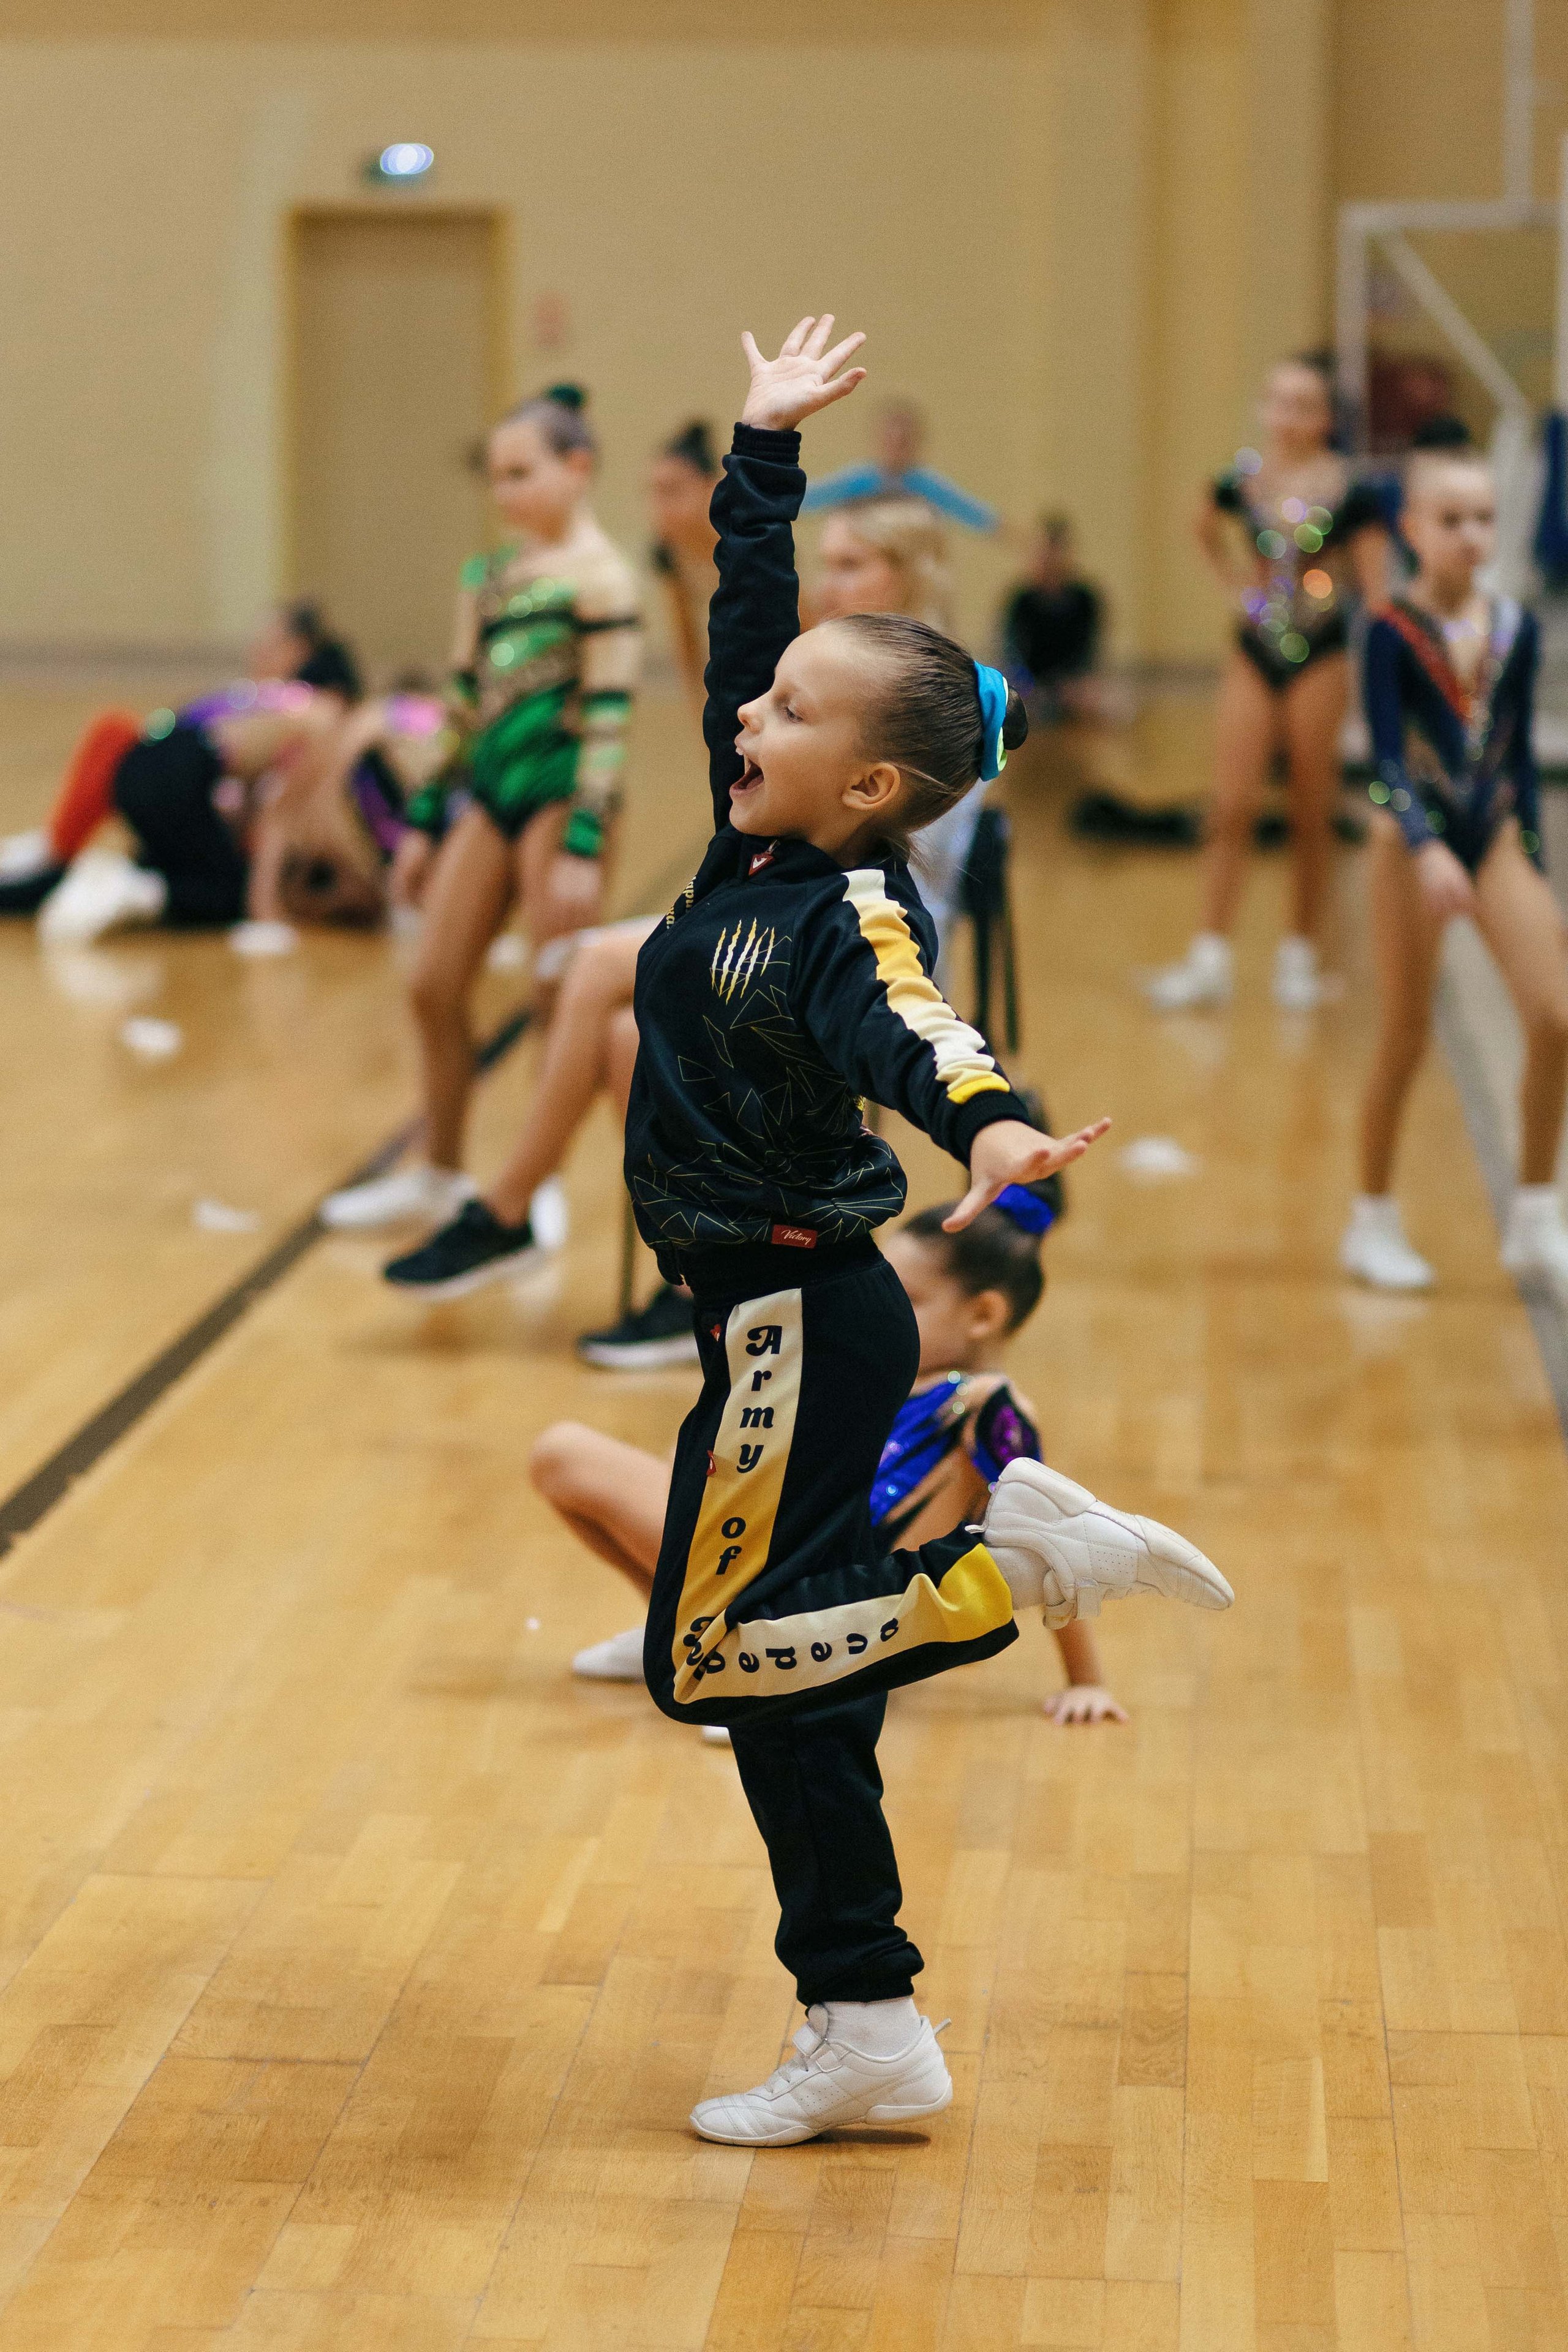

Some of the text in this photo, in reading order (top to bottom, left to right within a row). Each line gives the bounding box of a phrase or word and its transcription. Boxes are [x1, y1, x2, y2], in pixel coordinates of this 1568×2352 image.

[781, 1229, 812, 1245] Victory
[736, 1325, 783, 1474] Army
[715, 1517, 747, 1576] of
